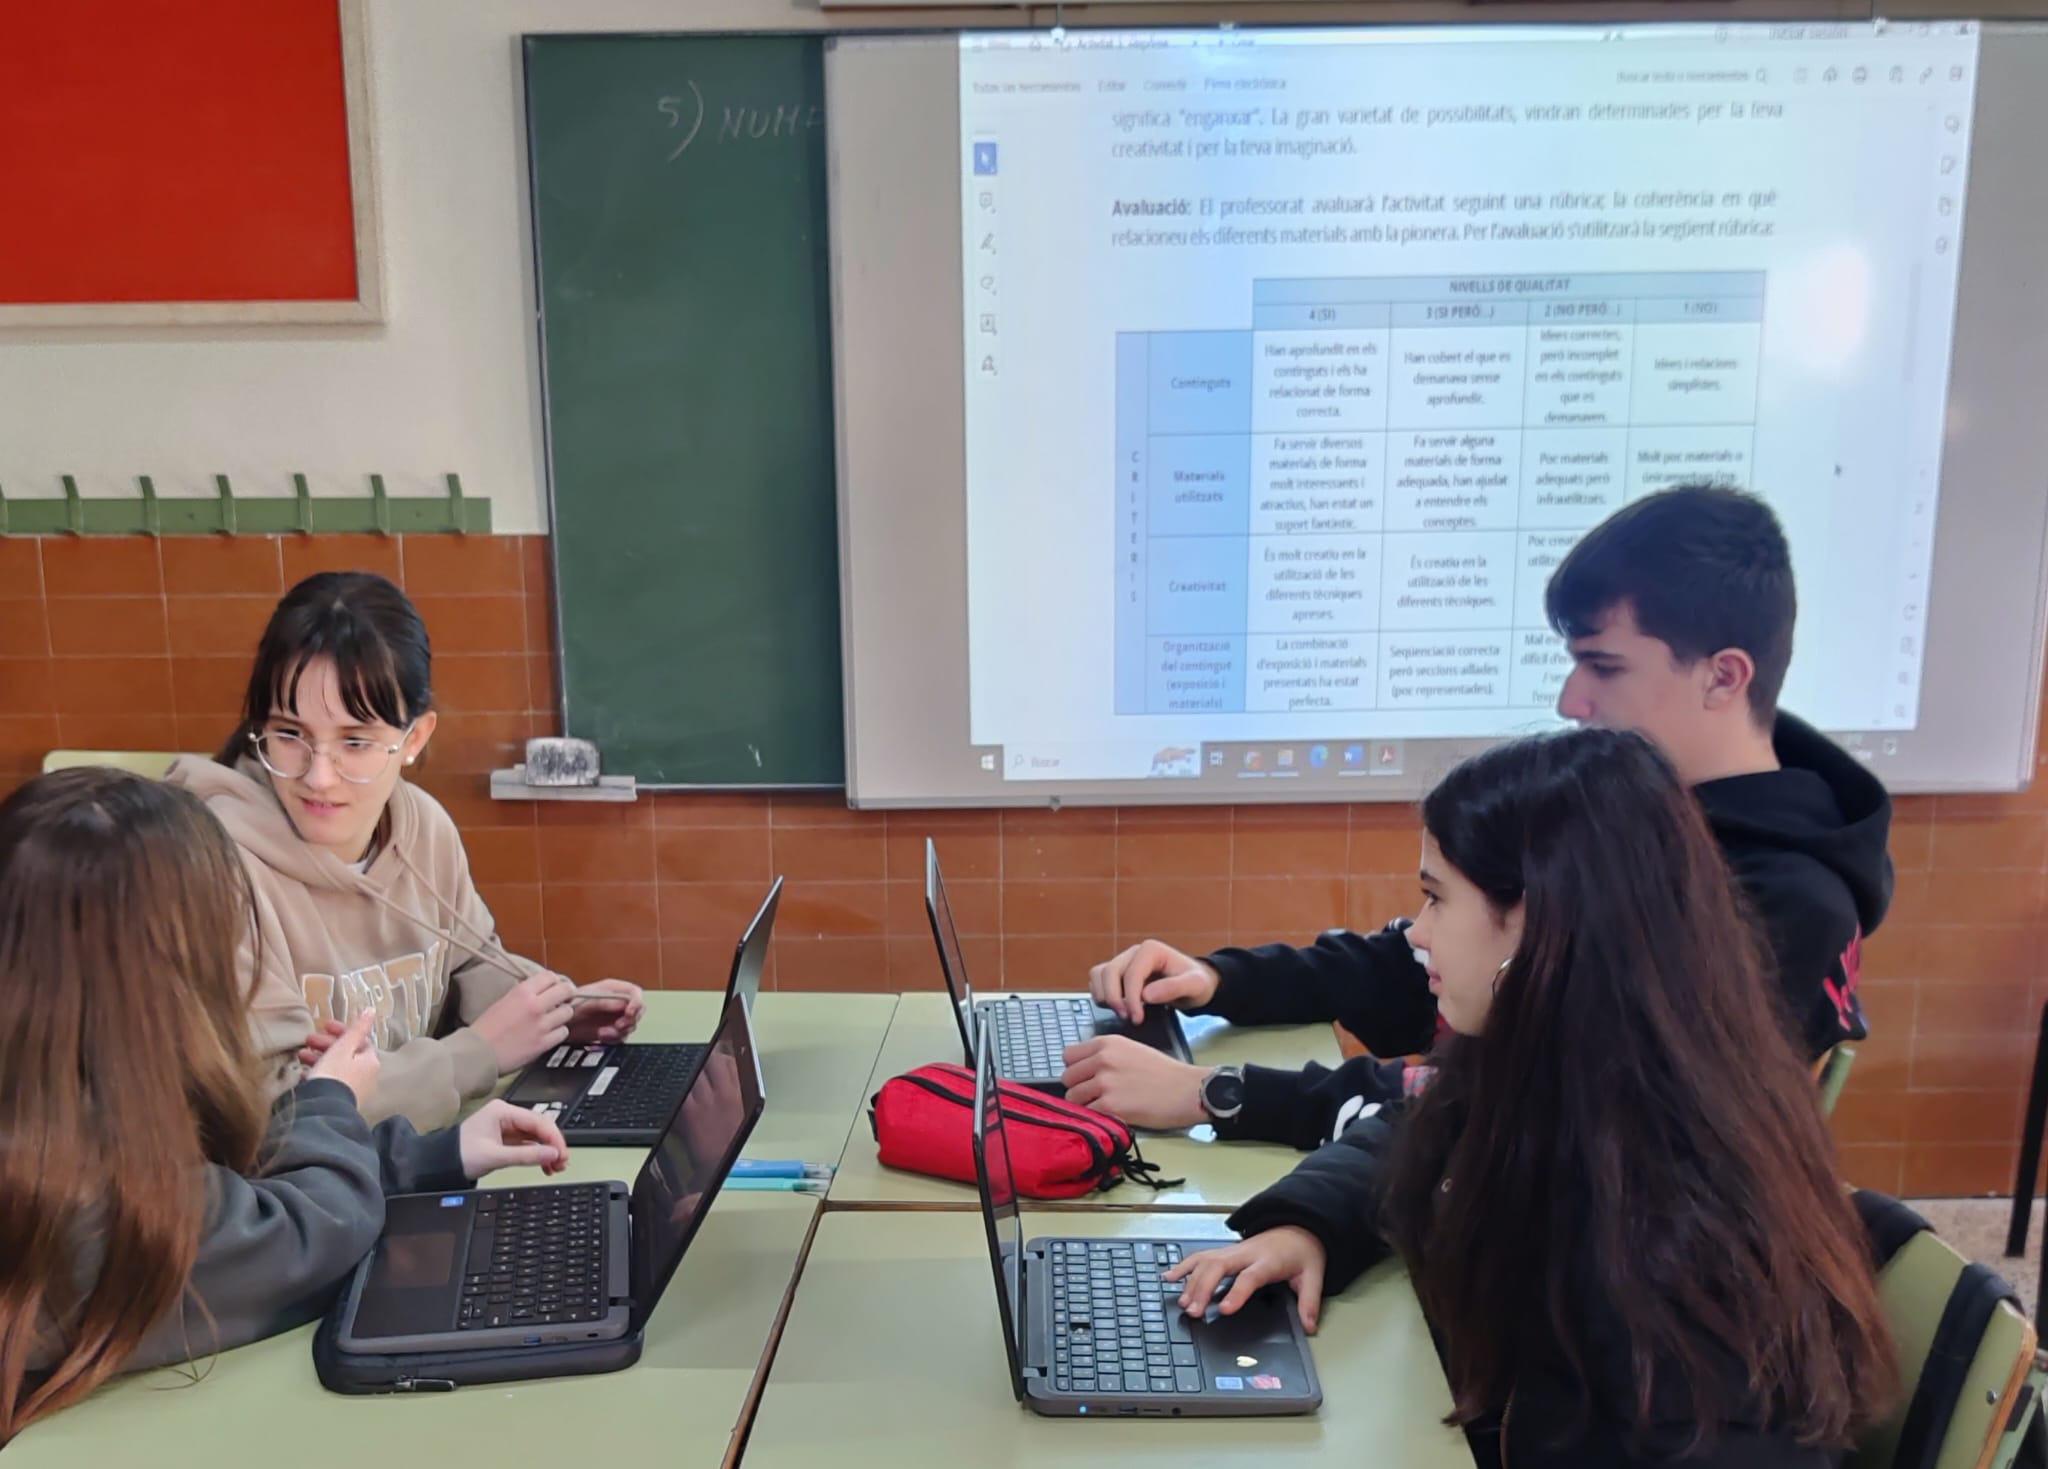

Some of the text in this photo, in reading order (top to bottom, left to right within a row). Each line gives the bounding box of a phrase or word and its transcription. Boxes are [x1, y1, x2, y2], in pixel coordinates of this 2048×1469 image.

[1111, 100, 1783, 133] significa La gran varietat de possibilitats, vindran determinades per la teva
[1111, 139, 1181, 157] creativitat
[1193, 141, 1219, 162] per
[1224, 139, 1238, 156] la
[1240, 138, 1271, 156] teva
[1111, 187, 1777, 219] Avaluació: El professorat avaluarà l'activitat seguint una la coherència en què
[1111, 228, 1187, 247] relacioneu
[1190, 227, 1211, 246] els
[1213, 226, 1277, 245] diferents
[1280, 225, 1347, 244] materials
[1349, 224, 1382, 243] amb
[1385, 224, 1398, 242] la
[1400, 223, 1460, 247] pionera.
[1463, 222, 1489, 241] Per
[1491, 220, 1563, 241] l'avaluació
[1642, 219, 1656, 238] la
[1449, 278, 1571, 294] NIVELLS DE QUALITAT
[1308, 307, 1316, 321] 4
[1552, 303, 1576, 317] (NO
[1265, 342, 1377, 360] Han aprofundit en els
[1404, 350, 1497, 367] Han cobert que
[1273, 361, 1369, 381] continguts els ha
[1413, 372, 1501, 385] demanava sense
[1170, 376, 1232, 392] Continguts
[1269, 383, 1370, 399] relacionat de forma
[1560, 392, 1580, 406] que
[1273, 435, 1363, 450] Fa servir diversos
[1413, 434, 1495, 450] Fa servir alguna
[1269, 454, 1368, 470] materials de forma
[1404, 452, 1503, 467] materials de forma
[1540, 450, 1609, 465] Poc materials
[1173, 469, 1226, 484] Materials
[1270, 476, 1359, 491] molt interessants
[1452, 472, 1473, 487] han
[1475, 472, 1508, 490] ajudat
[1174, 490, 1225, 504] utilitzats
[1309, 497, 1329, 511] han
[1331, 497, 1358, 510] estat
[1359, 499, 1375, 510] un
[1423, 493, 1488, 508] entendre els
[1274, 519, 1309, 534] suport
[1279, 548, 1356, 562] molt creatiu en
[1424, 555, 1476, 569] creatiu en
[1273, 567, 1356, 582] utilització de les
[1407, 573, 1489, 588] utilització de les
[1168, 578, 1227, 594] Creativitat
[1265, 588, 1311, 601] diferents
[1396, 594, 1443, 609] diferents
[1276, 637, 1349, 651] La combinació
[1457, 644, 1500, 658] correcta
[1160, 659, 1232, 676] del contingut
[1319, 655, 1368, 670] materials
[1388, 663, 1458, 680] però seccions
[1263, 676, 1360, 692] presentats ha estat
[1391, 685, 1413, 699] (poc
